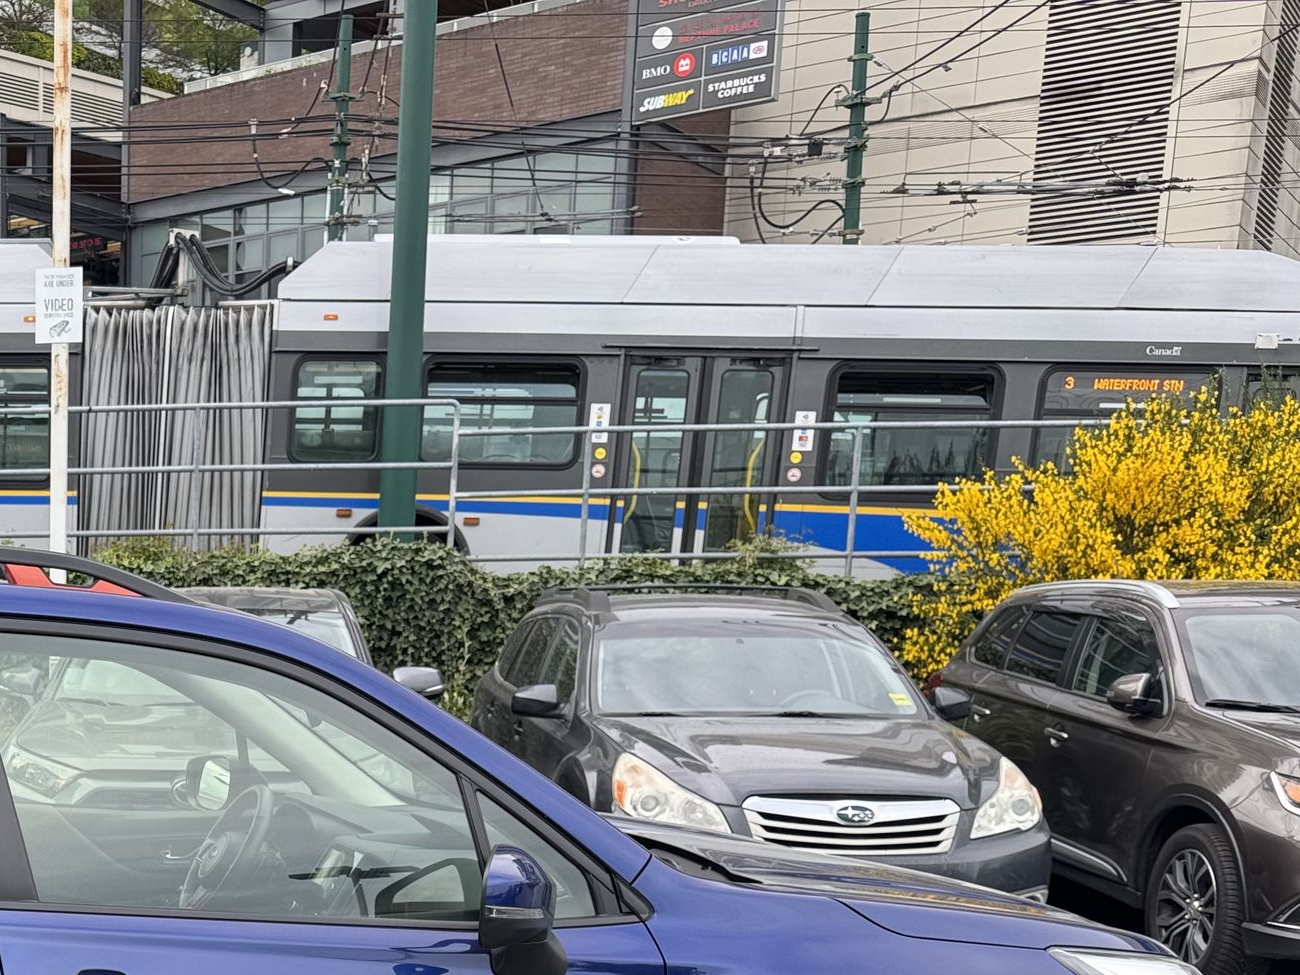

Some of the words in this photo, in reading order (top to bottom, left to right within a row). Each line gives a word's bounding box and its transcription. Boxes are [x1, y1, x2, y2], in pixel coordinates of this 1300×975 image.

[723, 18, 760, 34] PALACE
[711, 46, 749, 66] BCAA
[642, 65, 671, 80] BMO
[707, 73, 767, 92] STARBUCKS
[717, 84, 755, 99] COFFEE
[639, 88, 694, 112] SUBWAY
[43, 298, 74, 312] VIDEO
[1146, 345, 1182, 356] Canada
[1064, 376, 1076, 390] 3
[1093, 378, 1160, 391] WATERFRONT
[1162, 379, 1184, 392] STN
